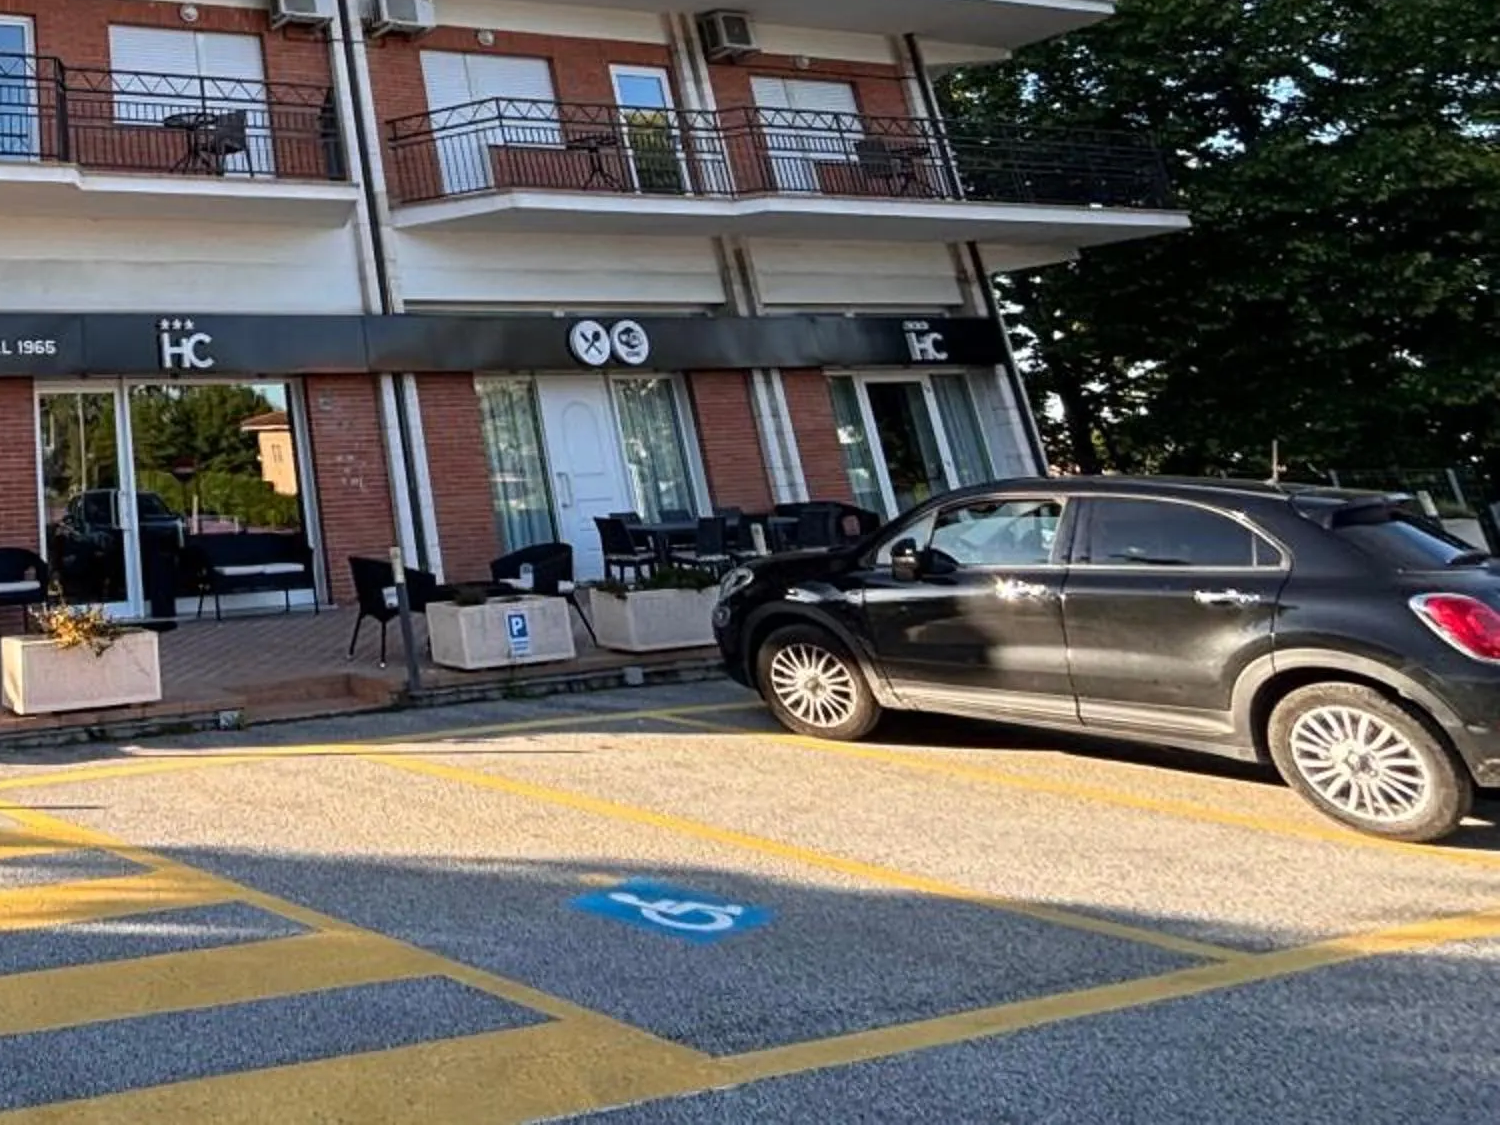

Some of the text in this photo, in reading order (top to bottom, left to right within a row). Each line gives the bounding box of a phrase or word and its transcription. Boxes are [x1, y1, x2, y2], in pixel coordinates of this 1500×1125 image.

[17, 339, 57, 355] 1965
[161, 332, 215, 369] HC
[510, 617, 523, 636] P
